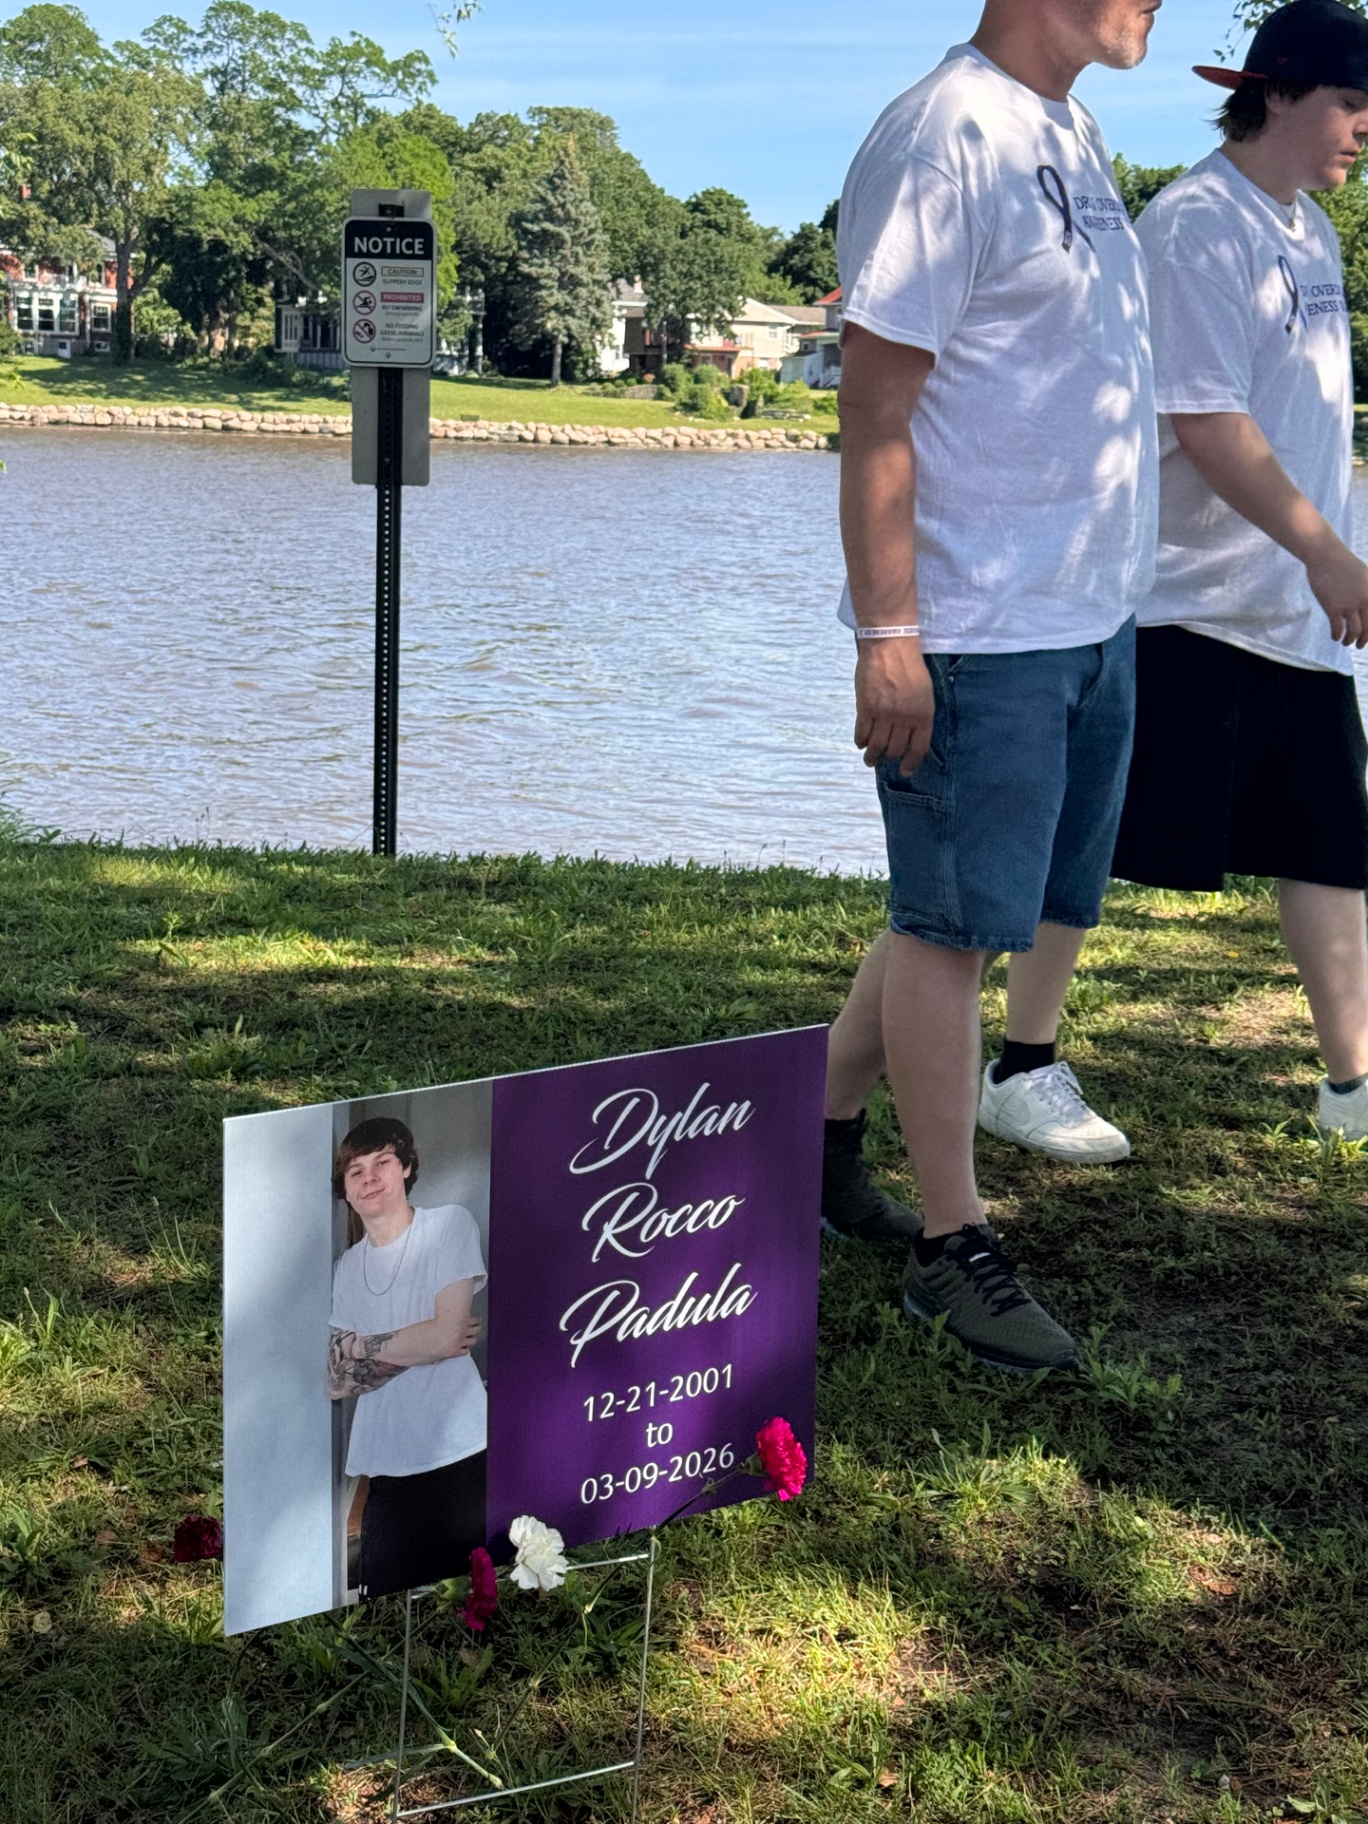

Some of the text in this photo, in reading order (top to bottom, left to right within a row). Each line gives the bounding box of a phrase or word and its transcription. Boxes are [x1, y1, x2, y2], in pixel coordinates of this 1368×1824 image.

[353, 236, 425, 255] NOTICE
[387, 268, 418, 276] CAUTION
[383, 293, 422, 301] PROHIBITED
[395, 322, 419, 330] FEEDING
[568, 1082, 757, 1180] Dylan
[581, 1181, 747, 1263] Rocco
[558, 1262, 759, 1368] Padula
[583, 1363, 733, 1422] 12-21-2001
[645, 1422, 674, 1448] to
[580, 1442, 735, 1505] 03-09-2026
